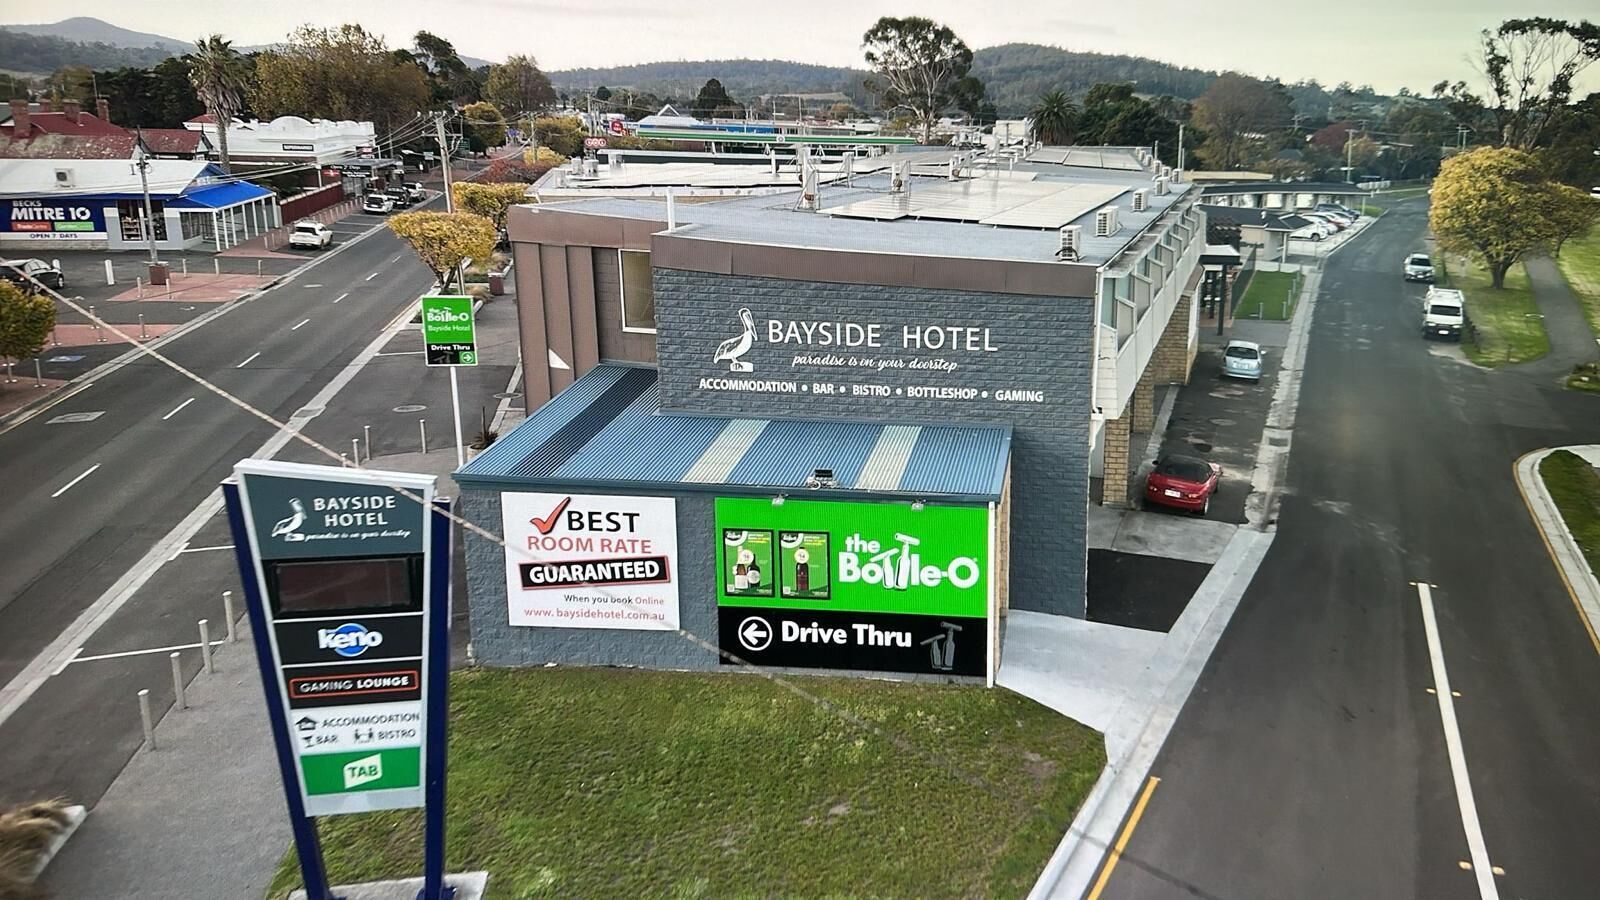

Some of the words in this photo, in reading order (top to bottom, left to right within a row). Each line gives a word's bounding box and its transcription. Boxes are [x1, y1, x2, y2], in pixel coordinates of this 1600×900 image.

[11, 207, 65, 220] MITRE
[69, 207, 91, 220] 10
[768, 319, 882, 348] BAYSIDE
[903, 325, 999, 352] HOTEL
[792, 354, 846, 367] paradise
[848, 356, 858, 366] is
[877, 360, 905, 371] your
[909, 357, 958, 373] doorstep
[699, 378, 797, 393] ACCOMMODATION
[812, 383, 835, 395] BAR
[852, 384, 891, 397] BISTRO
[907, 386, 978, 400] BOTTLESHOP
[995, 389, 1044, 403] GAMING
[313, 496, 396, 511] BAYSIDE
[325, 512, 389, 527] HOTEL
[567, 510, 640, 533] BEST
[527, 536, 594, 553] ROOM
[600, 538, 652, 554] RATE
[845, 533, 881, 554] the
[529, 560, 660, 584] GUARANTEED
[564, 594, 590, 604] When
[591, 596, 608, 604] you
[610, 595, 633, 604] book
[634, 596, 665, 605] Online
[317, 628, 383, 649] keno
[781, 620, 847, 645] Drive
[852, 623, 912, 648] Thru
[299, 680, 353, 693] GAMING
[356, 676, 409, 689] LOUNGE
[322, 713, 420, 728] ACCOMMODATION
[316, 735, 338, 744] BAR
[378, 729, 416, 739] BISTRO
[347, 765, 379, 778] TAB
